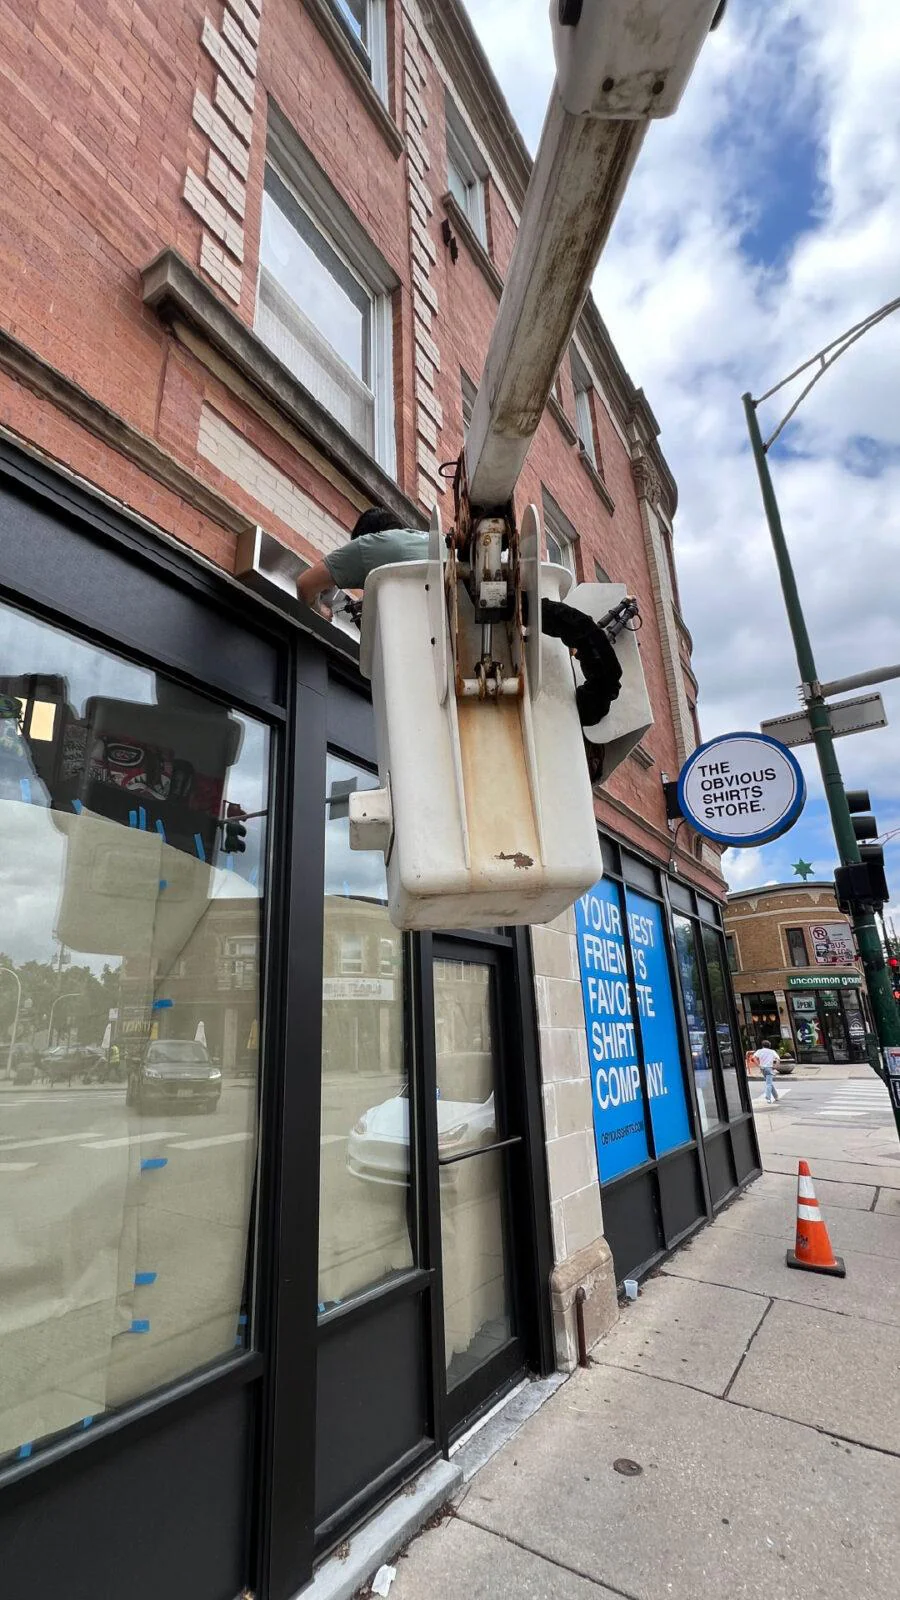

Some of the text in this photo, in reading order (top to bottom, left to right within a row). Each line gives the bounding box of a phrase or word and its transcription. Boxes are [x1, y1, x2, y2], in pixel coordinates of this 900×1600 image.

[698, 761, 731, 778] THE
[700, 768, 777, 791] OBVIOUS
[703, 785, 763, 805] SHIRTS
[704, 800, 765, 819] STORE.
[580, 893, 622, 936] YOUR
[790, 976, 840, 985] uncommon
[592, 1021, 635, 1062] SHIRT
[596, 1062, 668, 1110] COMPNY.
